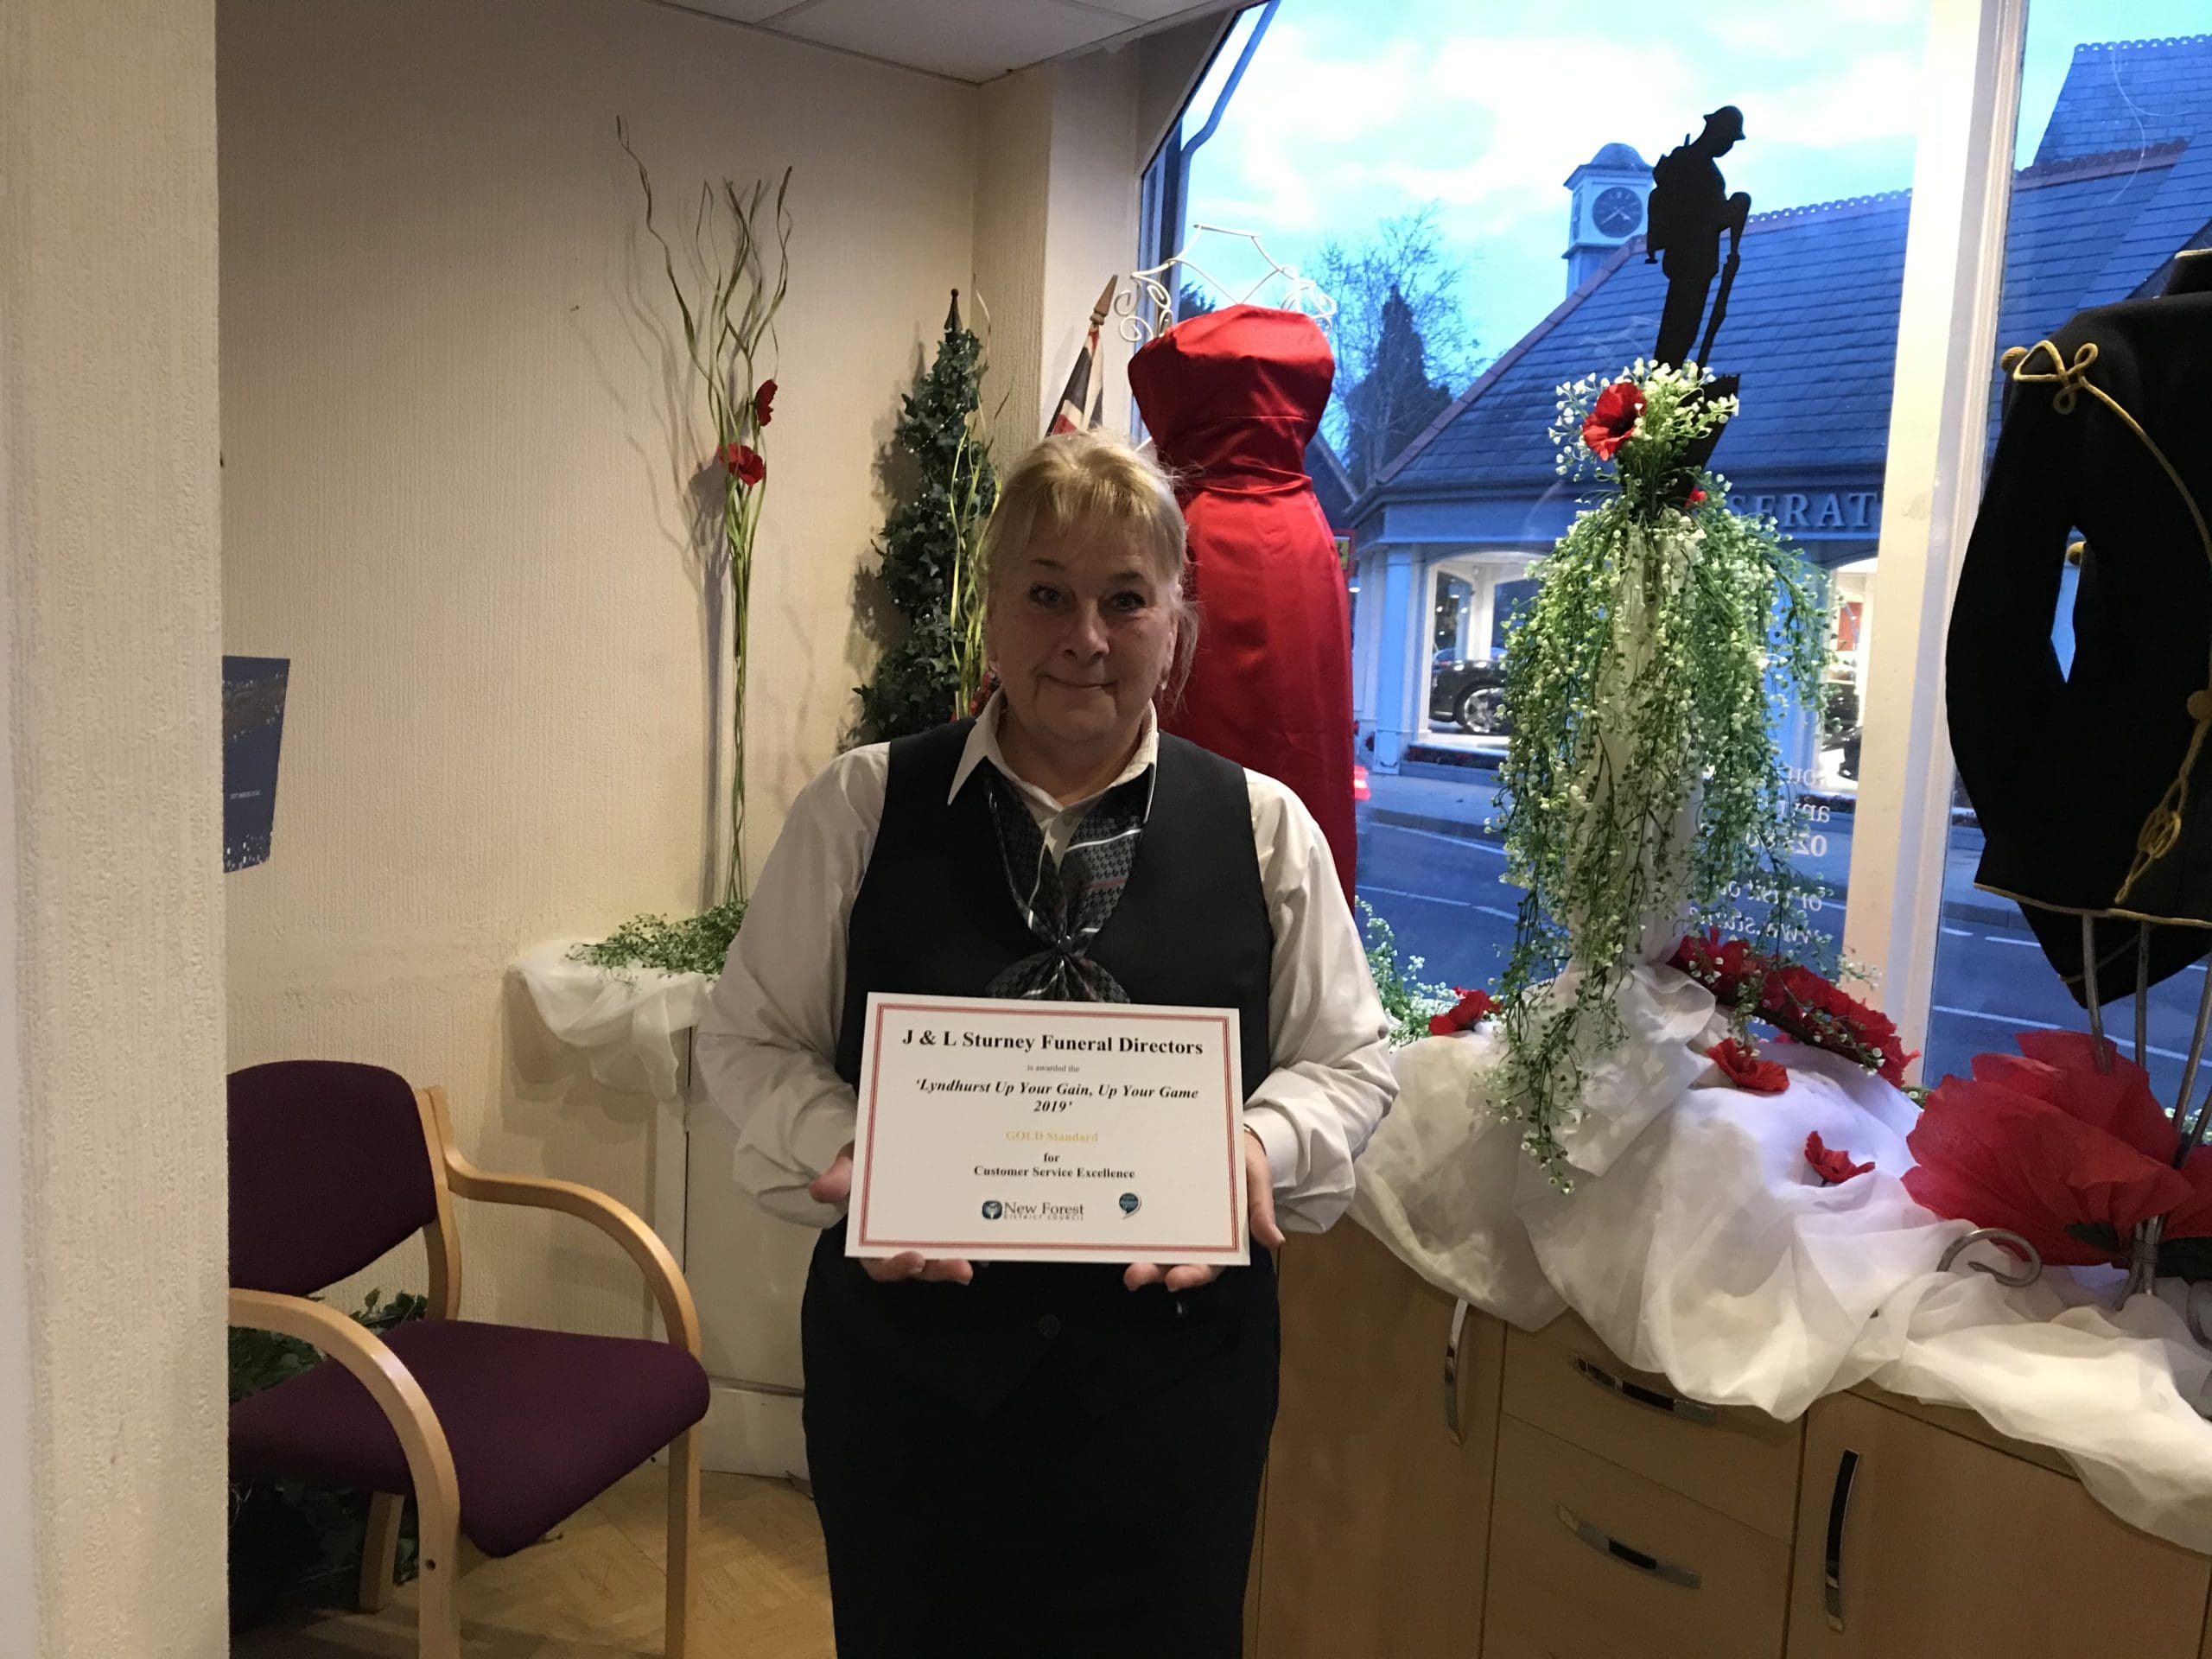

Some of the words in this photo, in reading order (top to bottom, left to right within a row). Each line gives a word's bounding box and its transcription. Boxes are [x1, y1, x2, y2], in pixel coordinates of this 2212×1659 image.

[902, 1029, 913, 1045] J
[919, 1030, 937, 1046] &
[944, 1031, 957, 1046] L
[963, 1031, 1035, 1053] Sturney
[1041, 1034, 1113, 1052] Funeral
[1119, 1037, 1204, 1054] Directors
[995, 1081, 1014, 1096] Up
[1020, 1082, 1052, 1095] Your
[1057, 1083, 1093, 1097] Gain,
[1098, 1084, 1118, 1099] Up
[1123, 1084, 1155, 1098] Your
[1159, 1085, 1199, 1099] Game
[1006, 1130, 1044, 1141] GOLD
[1046, 1131, 1099, 1143] Standard
[1043, 1152, 1060, 1163] for
[974, 1166, 1030, 1177] Customer
[1032, 1166, 1073, 1178] Service
[1077, 1166, 1136, 1179] Excellence
[1004, 1201, 1038, 1214] New
[1042, 1202, 1084, 1215] Forest
